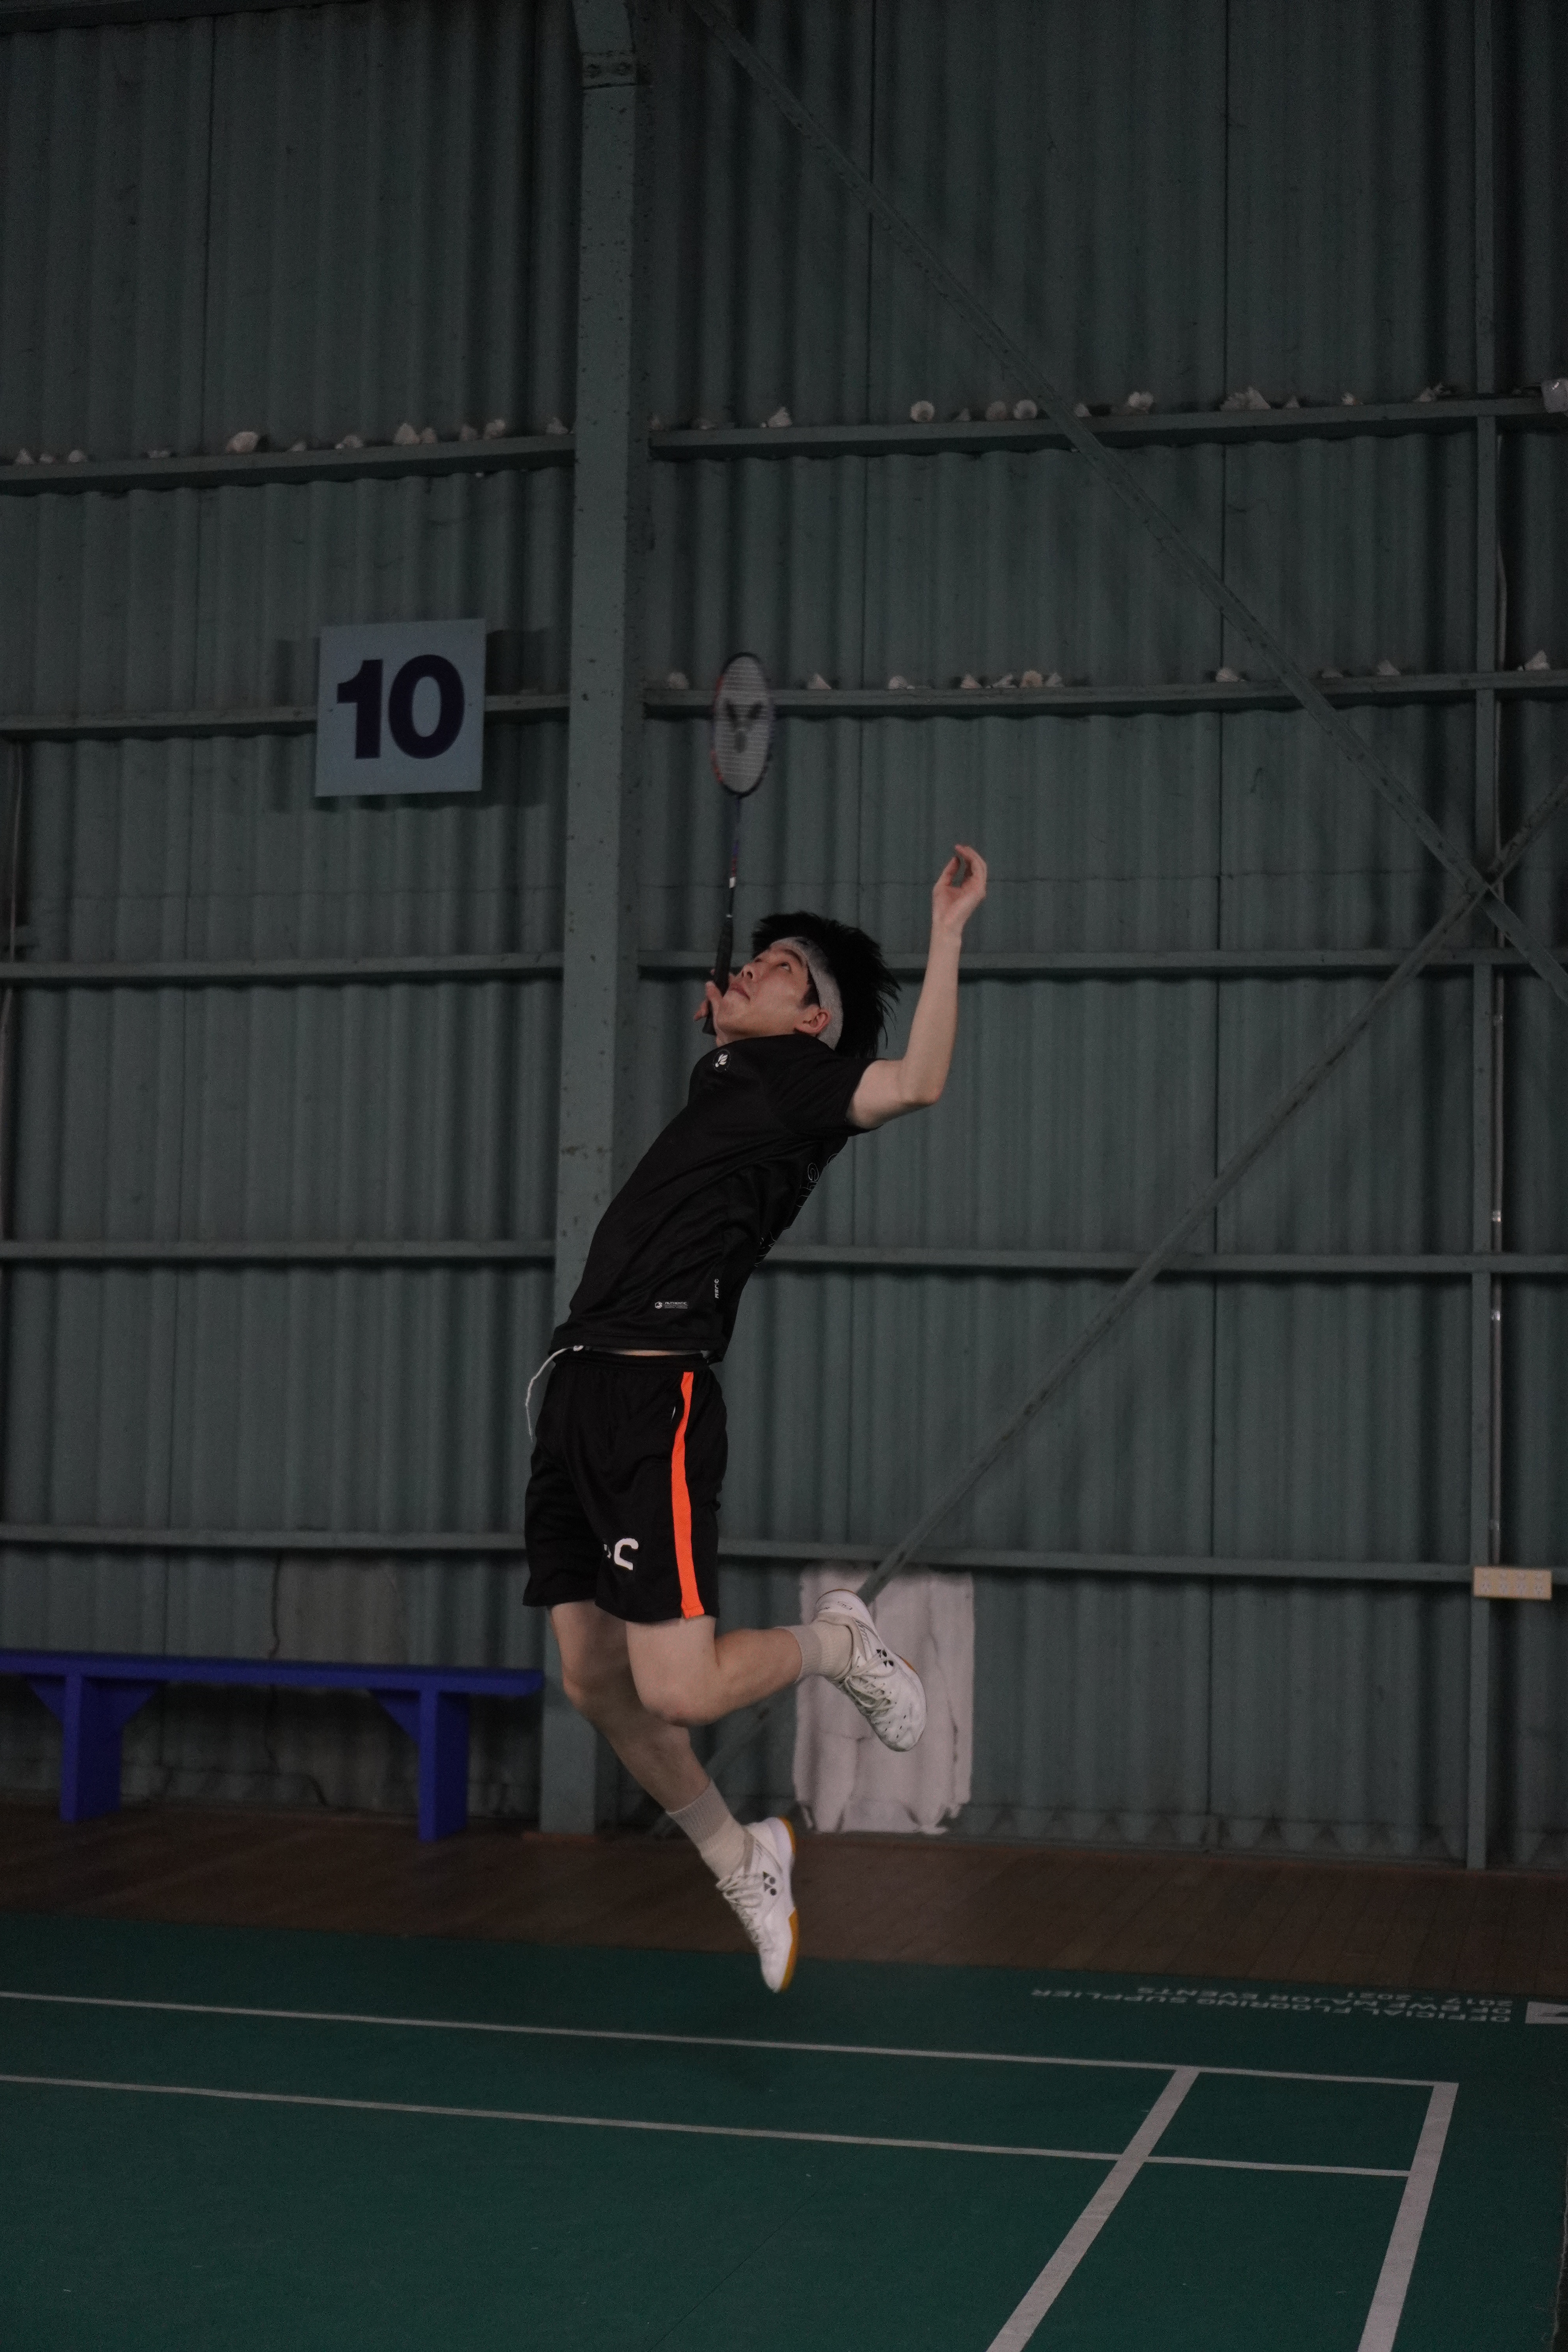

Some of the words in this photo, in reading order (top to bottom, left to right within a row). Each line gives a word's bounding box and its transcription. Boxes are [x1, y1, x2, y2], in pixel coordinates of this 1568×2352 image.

[337, 654, 465, 760] 10
[1031, 1989, 1187, 2004] SUPPLIER
[1137, 1987, 1258, 2000] EVENTS
[1269, 1994, 1378, 2007] MAJOR
[1197, 1999, 1352, 2013] FLOORING
[1471, 2006, 1512, 2014] OF
[1363, 2007, 1510, 2022] OFFICIAL
